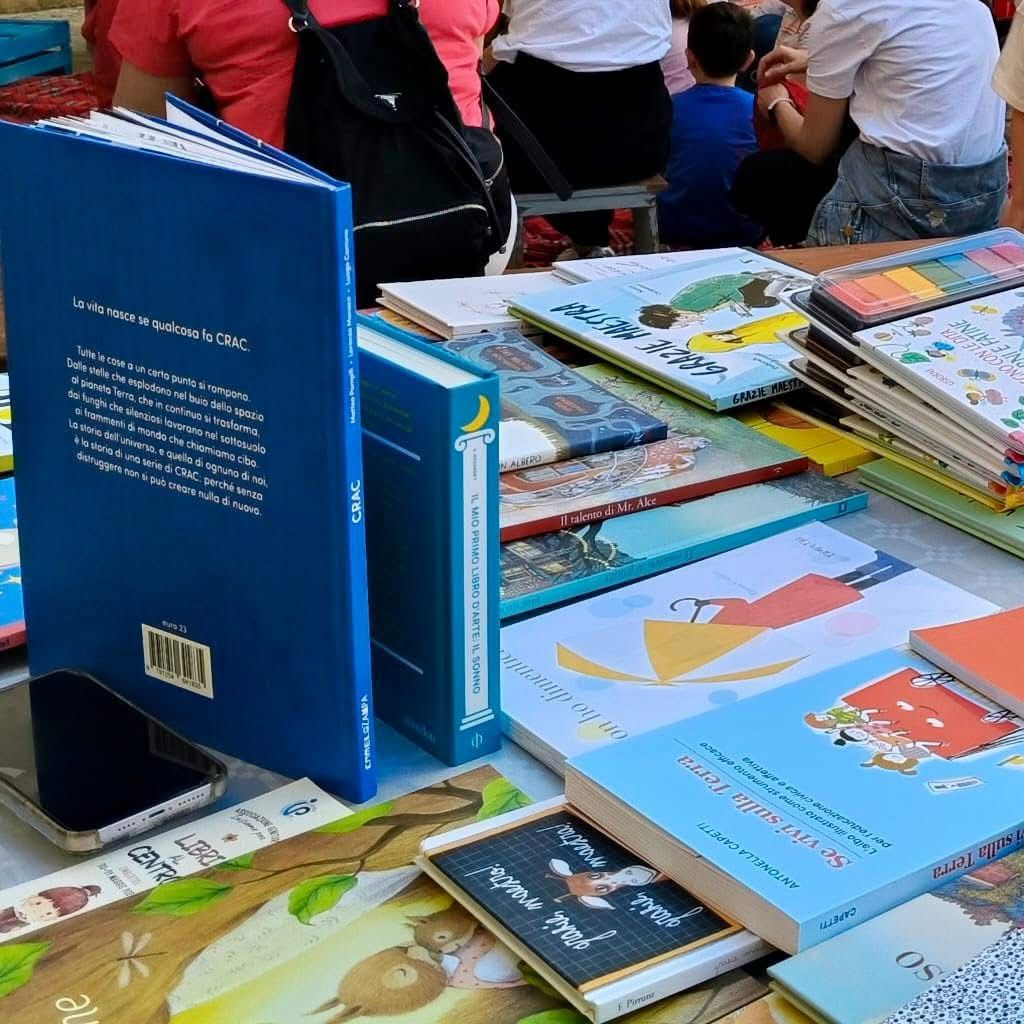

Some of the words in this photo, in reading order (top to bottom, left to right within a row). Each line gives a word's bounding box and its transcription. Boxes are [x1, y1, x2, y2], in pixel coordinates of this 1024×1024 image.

[87, 301, 104, 314] vita
[107, 307, 135, 322] nasce
[152, 319, 199, 340] qualcosa
[216, 332, 250, 352] CRAC.
[550, 302, 652, 340] MAESTRA
[949, 319, 1000, 347] FATINE
[647, 338, 729, 377] GRAZIE
[976, 350, 1003, 365] CON
[991, 345, 1010, 353] E
[77, 346, 96, 360] Tutte
[107, 357, 125, 369] cose
[147, 368, 170, 380] certo
[172, 374, 197, 389] punto
[208, 384, 251, 402] rompono.
[67, 358, 87, 372] Dalle
[89, 365, 109, 378] stelle
[112, 371, 126, 384] che
[128, 378, 172, 397] esplodono
[174, 390, 187, 401] nel
[189, 392, 208, 407] buio
[211, 398, 232, 413] dello
[234, 406, 264, 422] spazio
[732, 386, 767, 405] GRAZIE
[68, 390, 81, 400] dai
[83, 394, 107, 410] funghi
[109, 402, 124, 414] che
[125, 407, 163, 425] silenziosi
[164, 417, 203, 436] lavorano
[205, 430, 218, 441] nel
[220, 434, 266, 455] sottosuolo
[81, 379, 111, 395] pianeta
[113, 386, 136, 402] Terra,
[138, 395, 153, 407] che
[165, 402, 202, 421] continuo
[213, 416, 260, 438] trasforma,
[85, 409, 126, 429] frammenti
[138, 426, 167, 442] mondo
[169, 434, 184, 446] che
[186, 439, 235, 461] chiamiamo
[80, 422, 102, 437] storia
[104, 430, 157, 455] dell'universo,
[167, 451, 193, 466] quella
[206, 462, 239, 479] ognuno
[252, 475, 268, 488] noi,
[90, 440, 113, 456] storia
[125, 452, 140, 464] una
[142, 457, 163, 471] serie
[204, 476, 235, 493] perché
[237, 484, 263, 501] senza
[510, 455, 542, 469] ALBERO
[77, 452, 122, 473] distruggere
[124, 467, 140, 480] non
[150, 475, 166, 489] può
[168, 482, 196, 496] creare
[198, 489, 220, 504] nulla
[233, 499, 263, 517] nuovo.
[351, 479, 362, 524] CRAC
[471, 507, 481, 527] MIO
[559, 514, 569, 527] Il
[570, 509, 604, 526] talento
[604, 505, 615, 518] di
[617, 501, 636, 515] Mr.
[638, 496, 658, 511] Alce
[471, 530, 481, 564] PRIMO
[471, 567, 481, 599] LIBRO
[472, 644, 481, 654] IL
[472, 656, 482, 695] SONNO
[574, 702, 600, 726] ho
[700, 741, 736, 767] efficace
[741, 756, 780, 783] affettiva
[677, 754, 732, 796] Terra
[733, 763, 779, 797] strumento
[731, 791, 785, 825] sulla
[778, 794, 808, 813] come
[784, 785, 814, 805] civica
[697, 822, 741, 851] CAPETTI
[774, 822, 821, 850] vivi
[805, 809, 847, 838] illustrato
[174, 832, 226, 867] LIBRI
[871, 833, 894, 850] per
[978, 836, 1013, 861] sulla
[738, 848, 801, 890] ANTONELLA
[820, 846, 854, 870] Se
[932, 850, 977, 880] Terra
[819, 906, 858, 931] CAPETTI
